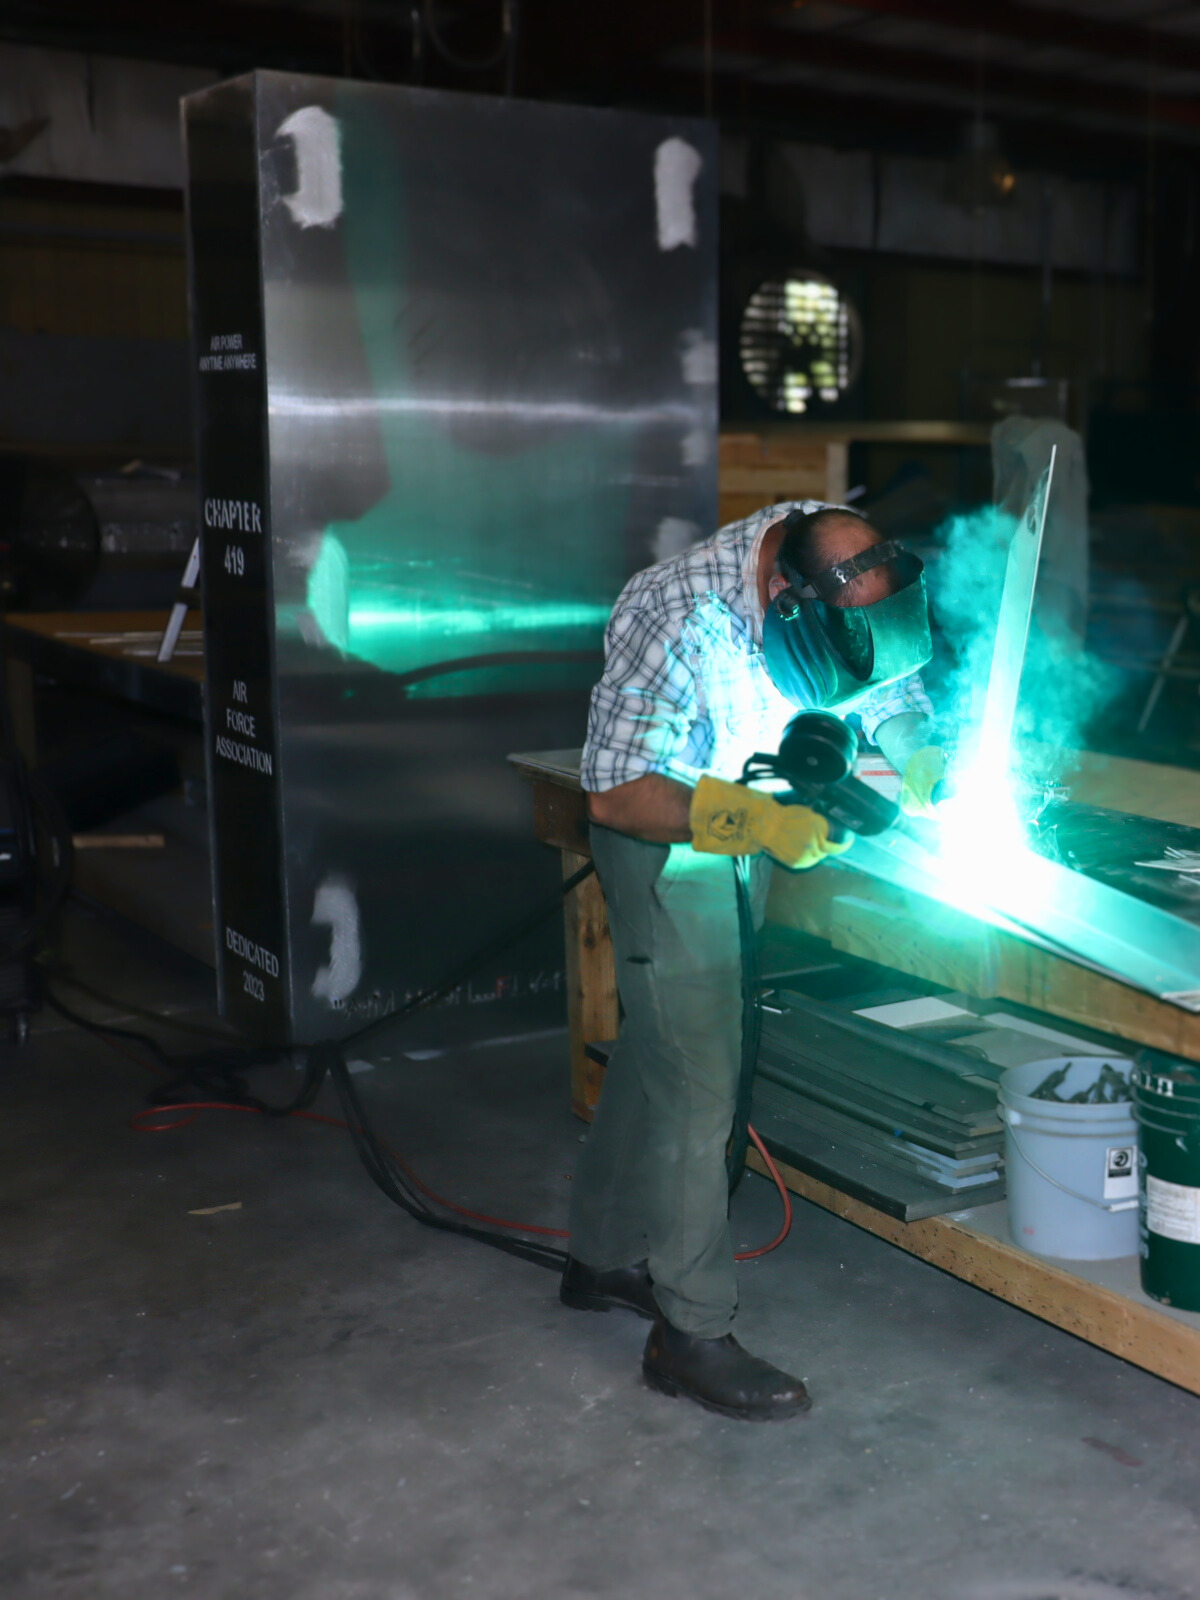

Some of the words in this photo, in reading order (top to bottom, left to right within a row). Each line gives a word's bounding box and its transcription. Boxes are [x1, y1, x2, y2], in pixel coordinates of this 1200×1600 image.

[221, 334, 243, 350] POWER
[199, 355, 223, 371] ANYTIME
[224, 353, 257, 370] ANYWHERE
[204, 498, 262, 533] CHAPTER
[224, 545, 244, 576] 419
[232, 680, 248, 704] AIR
[226, 708, 256, 738] FORCE
[216, 735, 273, 776] ASSOCIATION
[226, 926, 279, 978] DEDICATED
[243, 970, 265, 1002] 2023
